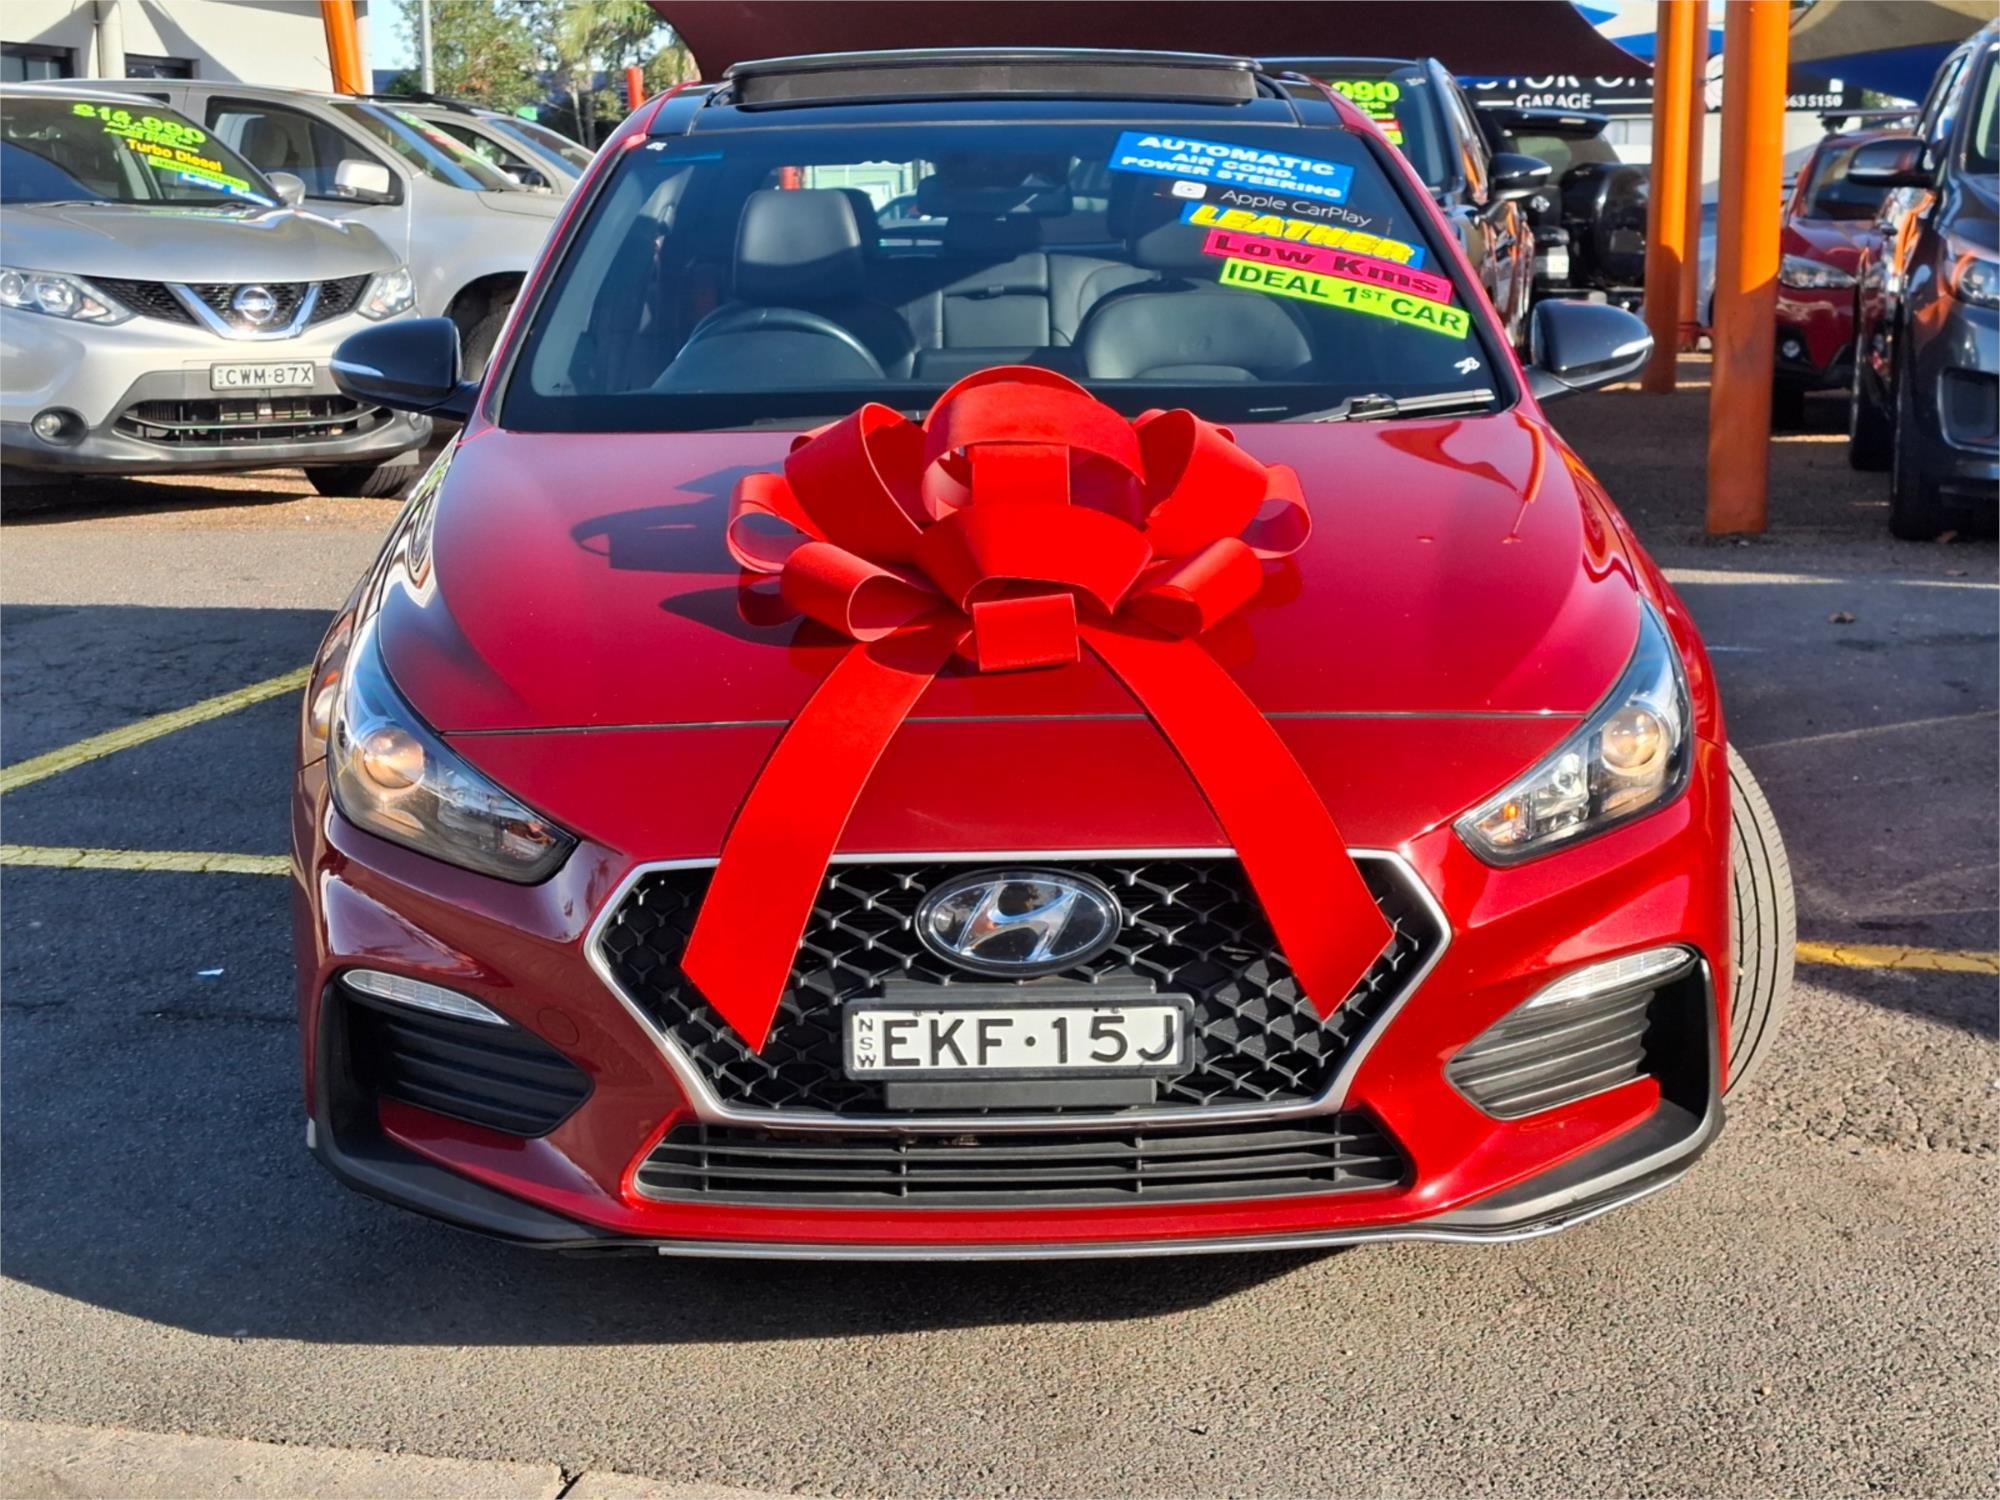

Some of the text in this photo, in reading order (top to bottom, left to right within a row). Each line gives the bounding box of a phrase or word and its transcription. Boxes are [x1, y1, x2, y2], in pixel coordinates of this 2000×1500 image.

[1515, 94, 1592, 109] GARAGE
[1784, 95, 1806, 108] 63
[126, 138, 223, 172] Turbo Diesel
[1137, 136, 1335, 176] AUTOMATIC
[1171, 153, 1298, 180] AIR COND.
[1121, 156, 1342, 198] POWER STEERING
[1220, 190, 1372, 227] Apple CarPlay
[1189, 204, 1415, 265] LEATHER
[1215, 234, 1438, 295] Low Kms
[1227, 263, 1461, 332] IDEAL 1ST CAR
[857, 1018, 877, 1068] NSW
